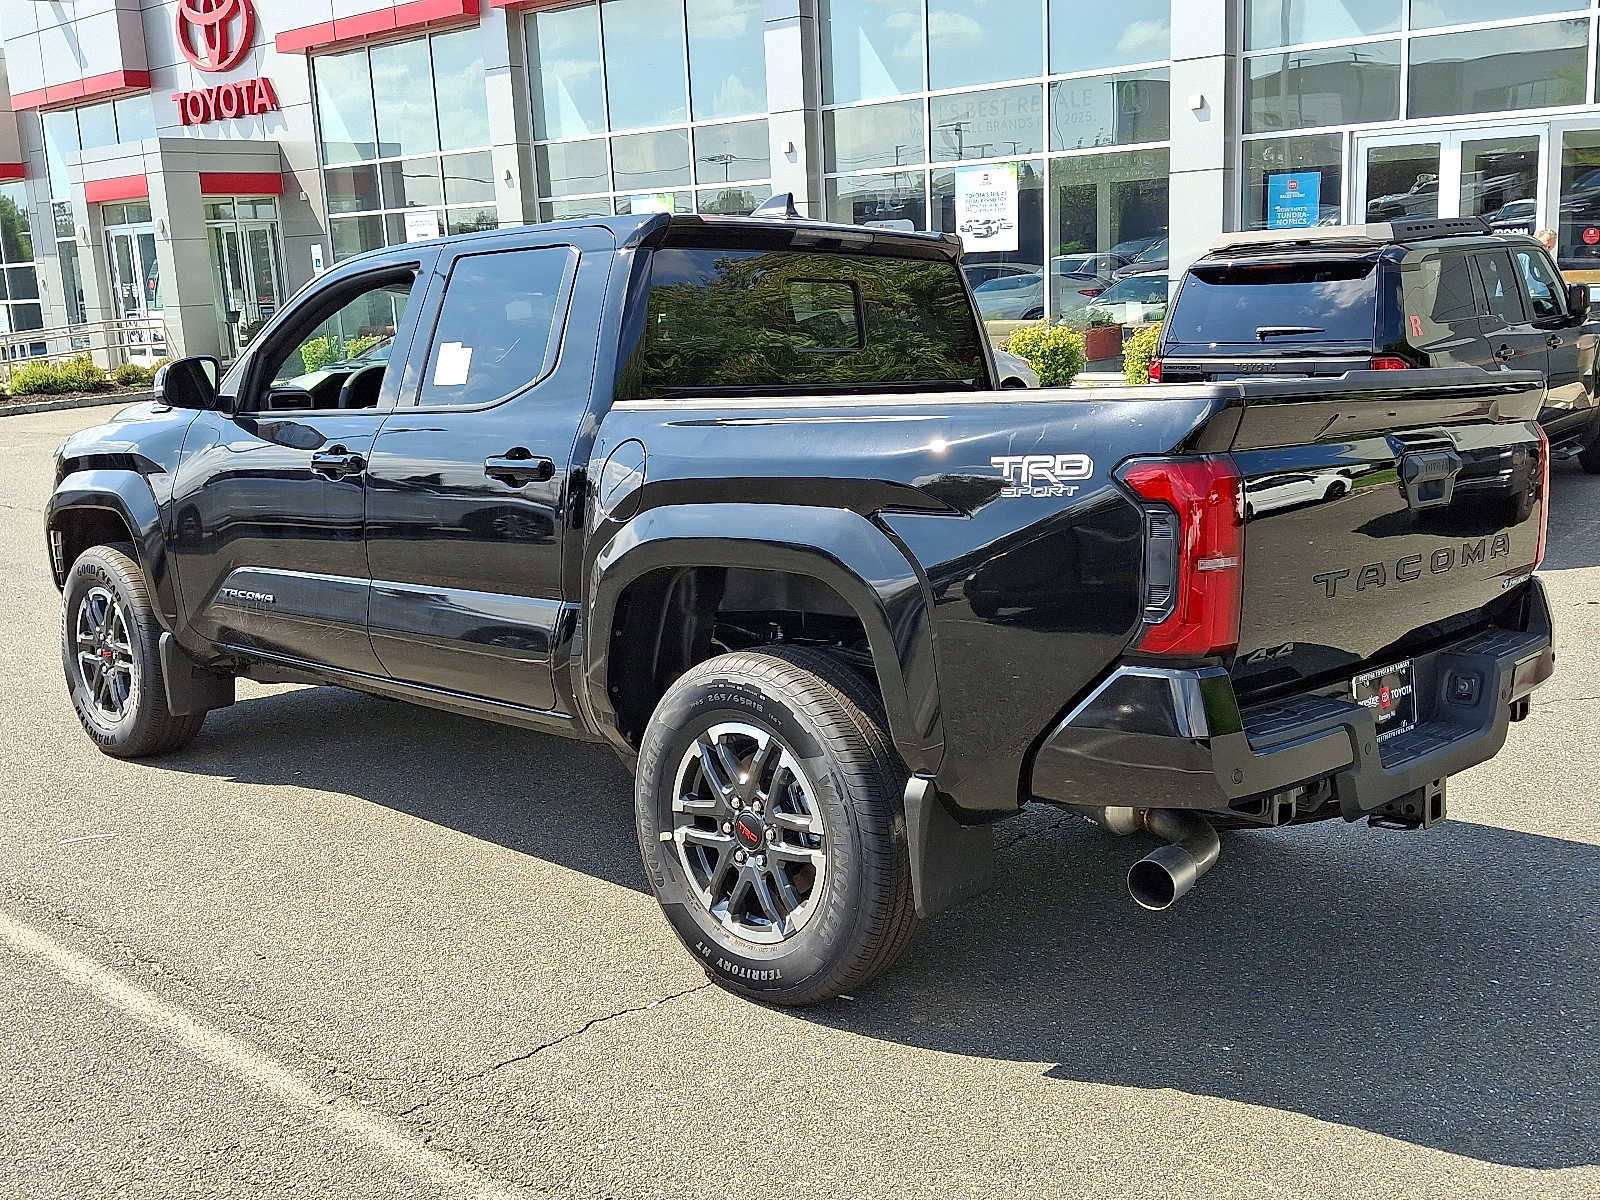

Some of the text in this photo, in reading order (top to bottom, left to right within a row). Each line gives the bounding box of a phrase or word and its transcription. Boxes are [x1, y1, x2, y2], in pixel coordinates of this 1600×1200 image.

[171, 77, 281, 126] TOYOTA
[966, 101, 1009, 120] BEST
[1017, 88, 1093, 113] REALE
[986, 119, 1032, 132] BRANDS
[1410, 315, 1424, 336] R
[1234, 363, 1279, 374] TOYOTA
[991, 454, 1094, 486] TRD
[1000, 485, 1079, 498] SPORT
[1313, 533, 1511, 599] TACOMA
[221, 588, 275, 604] TACOMA
[1391, 684, 1412, 699] TOYOTA
[707, 693, 764, 713] 265/65R18
[738, 820, 758, 844] TRD
[695, 941, 782, 981] TERRITORY HT
